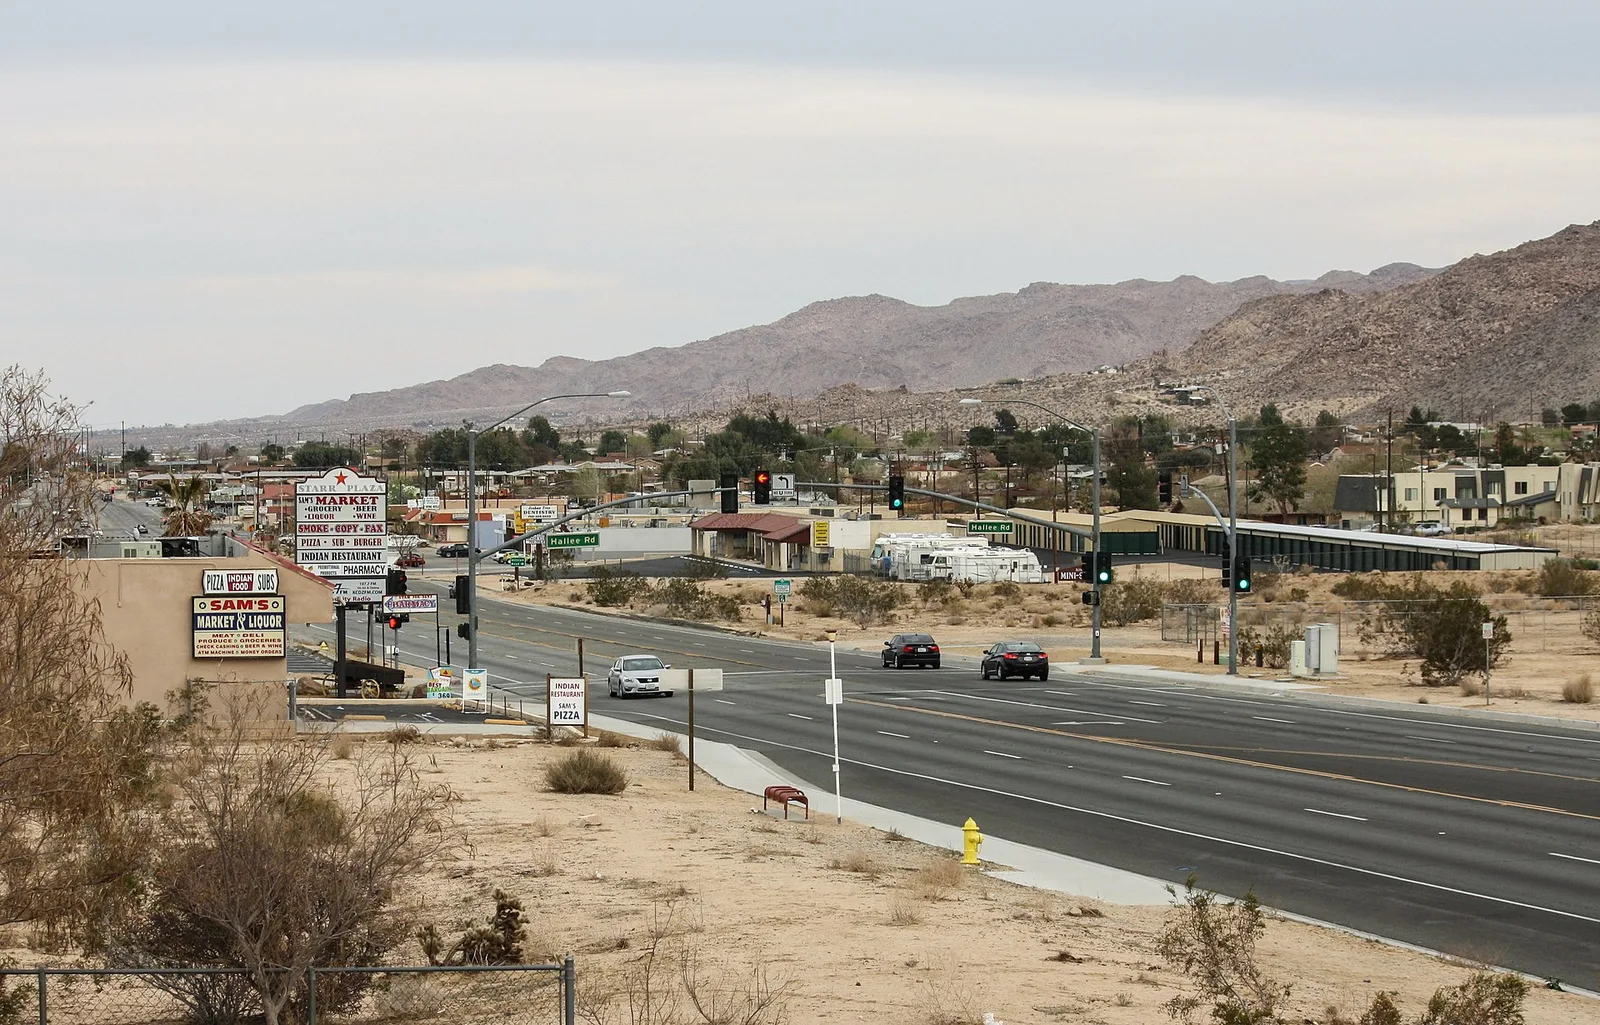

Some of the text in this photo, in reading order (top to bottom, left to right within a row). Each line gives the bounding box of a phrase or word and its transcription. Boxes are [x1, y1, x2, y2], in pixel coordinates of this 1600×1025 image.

[316, 496, 378, 505] MARKET
[298, 524, 329, 532] SMOKE
[364, 524, 383, 532] FAX
[332, 552, 382, 560] RESTAURANT
[344, 565, 385, 574] PHARMACY
[207, 574, 274, 590] PIZZA SUBS
[210, 600, 269, 610] SAM'S
[388, 600, 436, 608] PHARMACY
[197, 612, 282, 629] MARKET & LIQUOR
[554, 711, 580, 719] PIZZA
